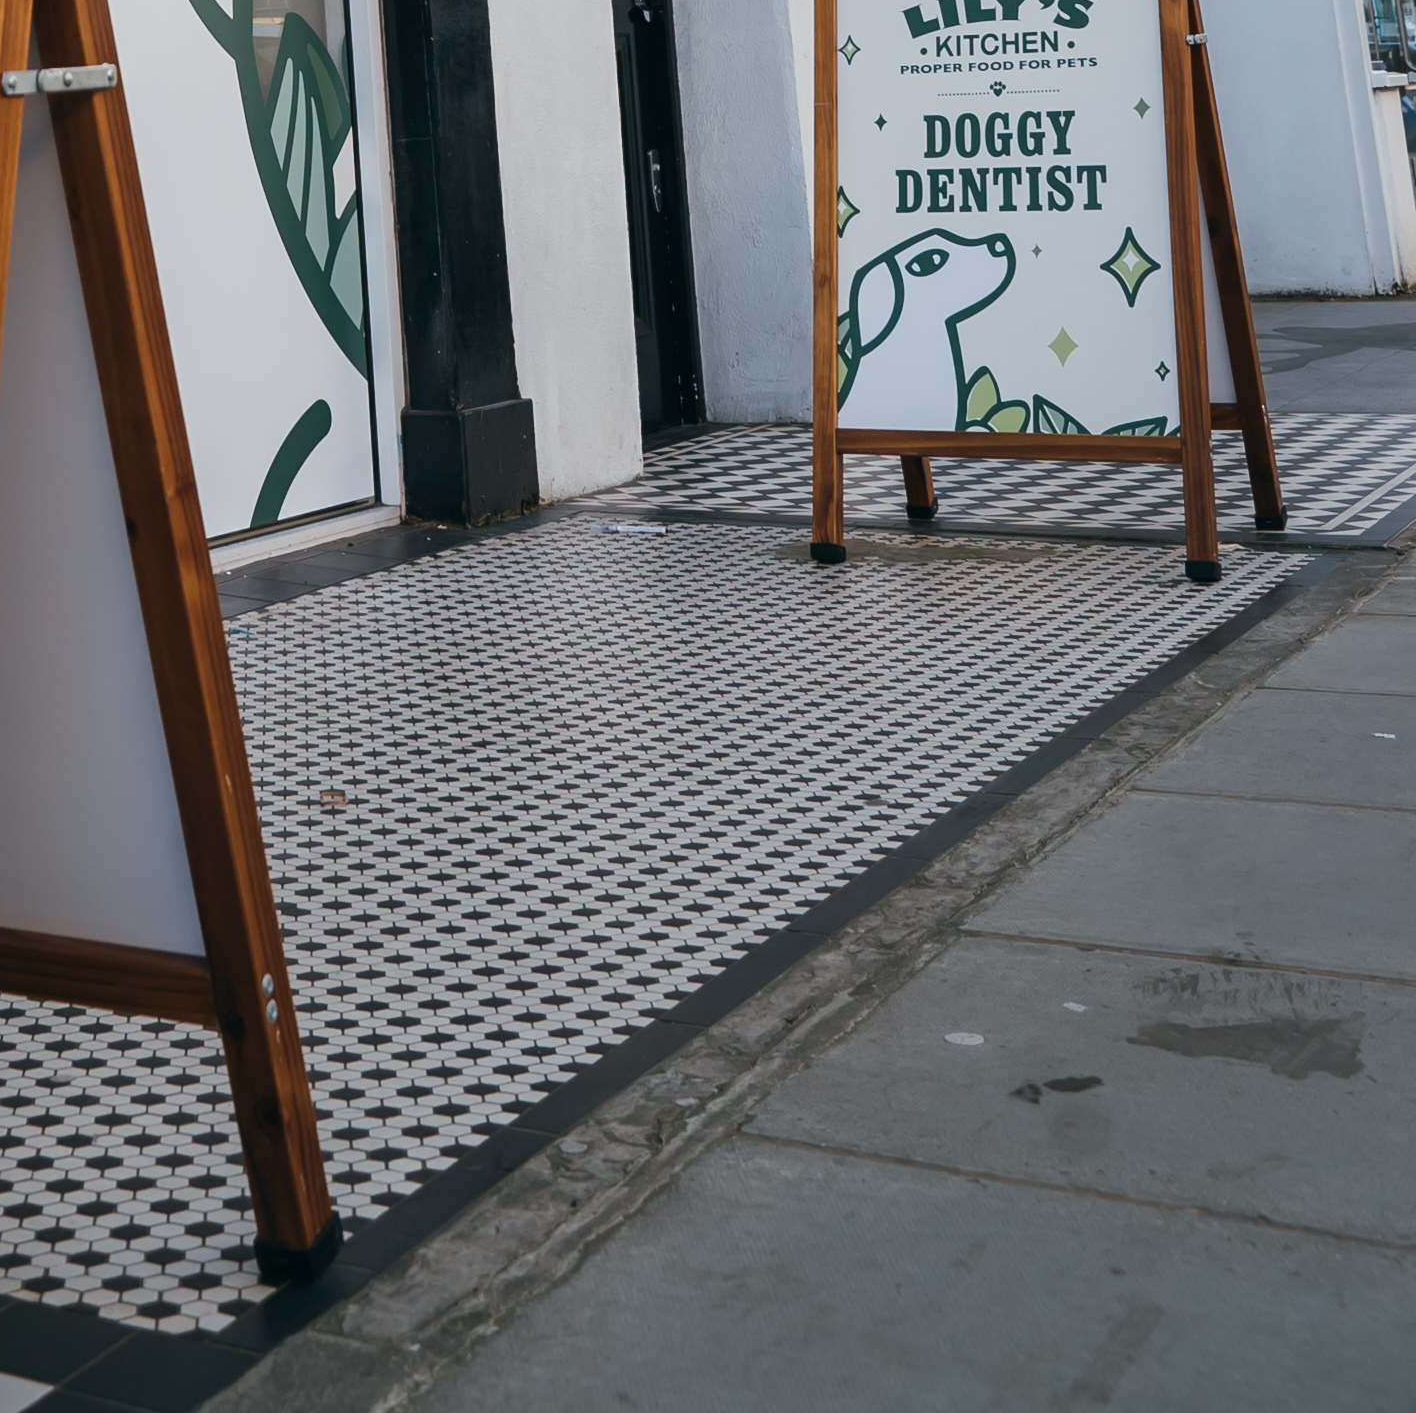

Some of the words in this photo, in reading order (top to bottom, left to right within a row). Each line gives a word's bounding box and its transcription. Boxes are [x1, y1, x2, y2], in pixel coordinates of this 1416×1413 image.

[934, 30, 1060, 58] KITCHEN
[899, 63, 963, 76] PROPER
[968, 60, 1015, 73] FOOD
[1019, 58, 1052, 71] FOR
[1056, 56, 1099, 69] PETS
[923, 110, 1076, 159] DOGGY
[894, 164, 1108, 214] DENTIST
